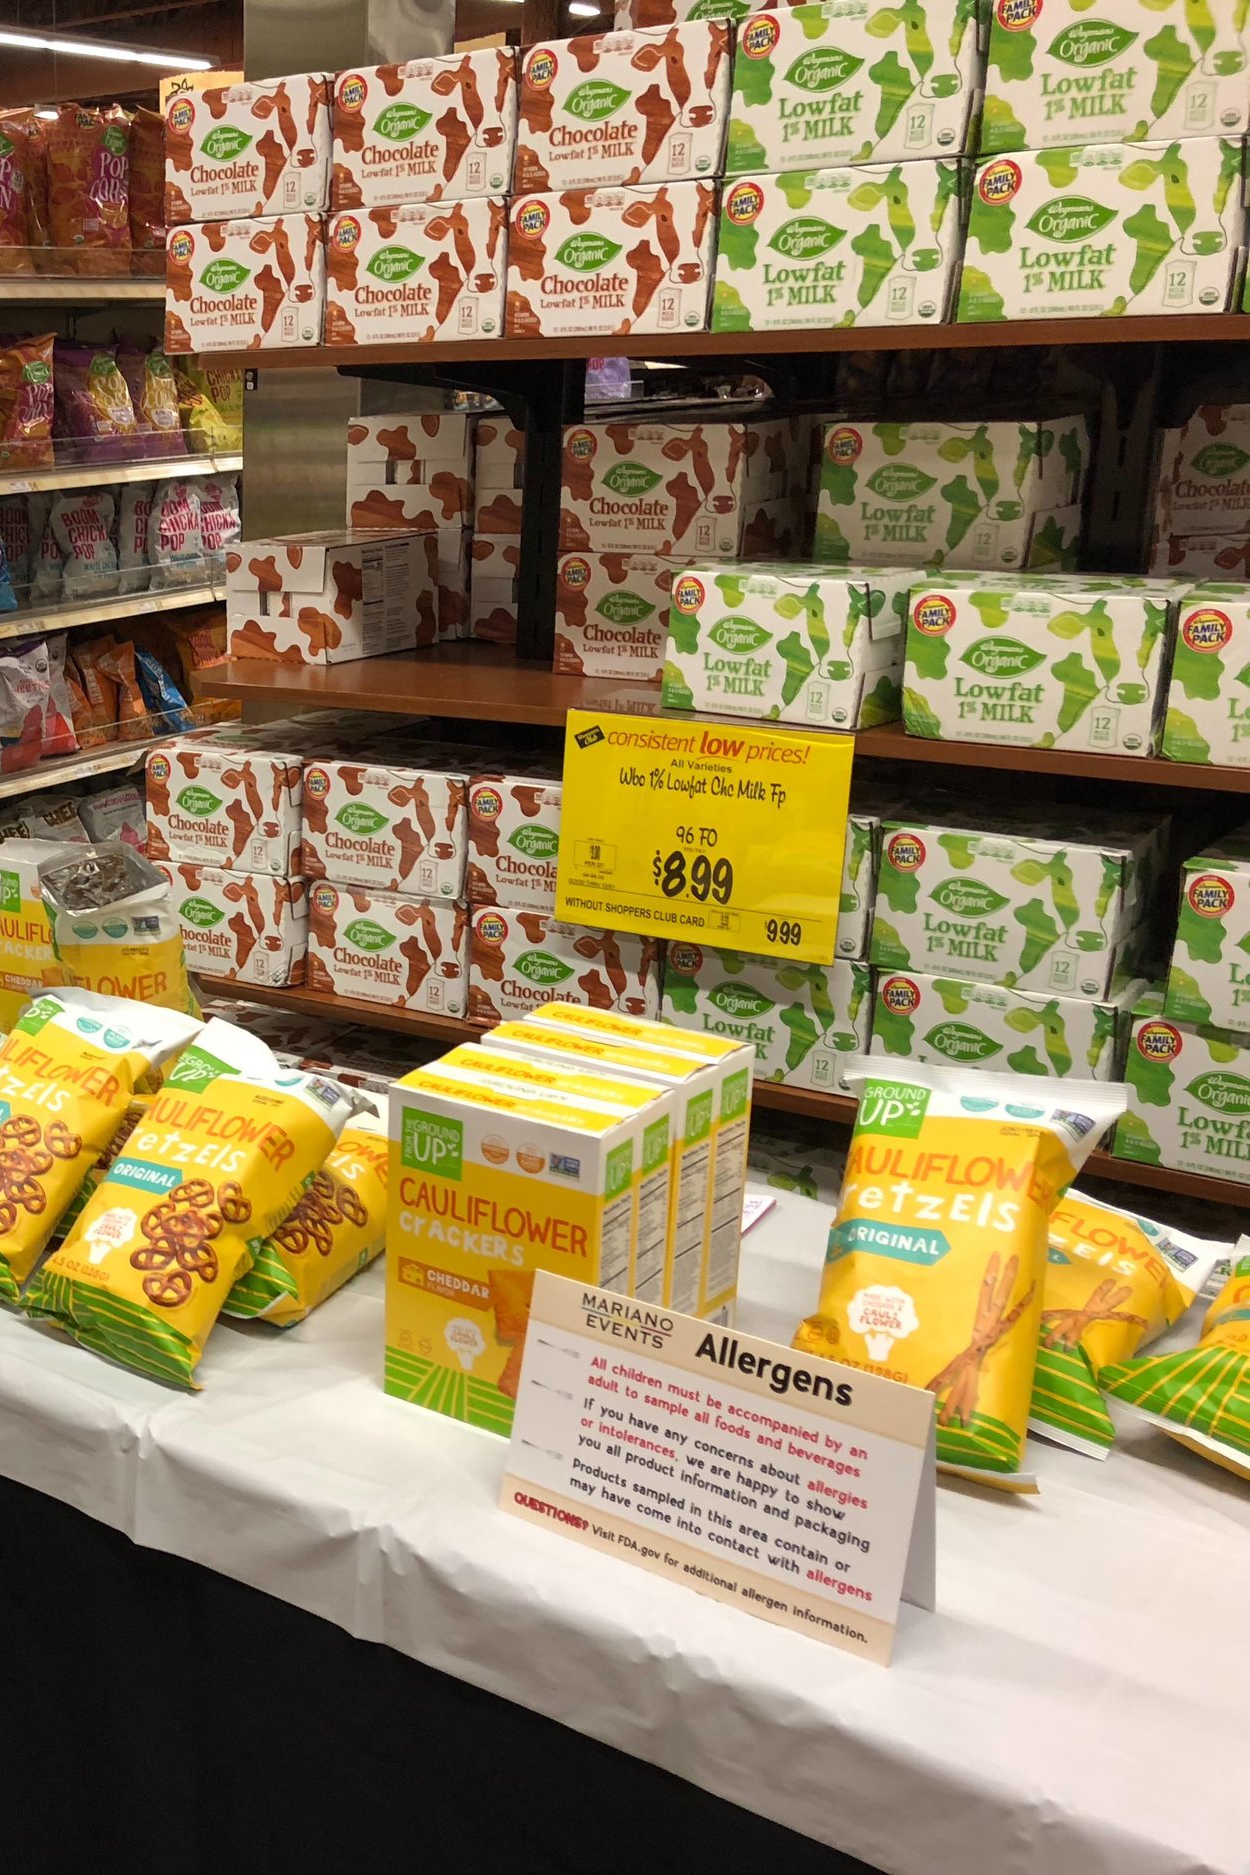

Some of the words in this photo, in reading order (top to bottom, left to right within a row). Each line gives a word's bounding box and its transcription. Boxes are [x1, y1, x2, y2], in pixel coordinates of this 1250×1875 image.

[1041, 67, 1137, 95] Lowfat
[1068, 94, 1127, 119] MILK
[983, 172, 1015, 188] FAMILY
[985, 182, 1015, 197] PACK
[1047, 203, 1093, 217] Wegmans
[1038, 212, 1099, 238] Organic
[564, 240, 609, 267] Organic
[1019, 244, 1116, 271] Lowfat
[540, 273, 629, 295] Chocolate
[1047, 271, 1105, 291] MILK
[1168, 272, 1186, 287] 12
[189, 295, 257, 314] Chocolate
[540, 297, 577, 309] Lowfat
[592, 294, 625, 308] MILK
[61, 511, 99, 526] BOOM
[73, 544, 95, 559] POP
[953, 681, 1044, 704] Lowfat
[974, 703, 1033, 724] MILK
[608, 730, 696, 753] consistent
[700, 731, 744, 758] low
[746, 746, 810, 764] prices!
[671, 759, 685, 768] All
[688, 761, 732, 773] Varieties
[620, 767, 646, 786] Wbo
[650, 768, 664, 789] 1%
[667, 776, 707, 798] Lowfat
[711, 776, 734, 798] Chc
[738, 782, 766, 800] Milk
[770, 784, 786, 808] Fp
[325, 832, 395, 856] Chocolate
[676, 826, 694, 843] 96
[700, 828, 718, 847] FO
[366, 852, 393, 870] MILK
[566, 897, 603, 912] WITHOUT
[606, 902, 651, 919] SHOPPERS
[654, 910, 678, 923] CLUB
[680, 914, 704, 927] CARD
[334, 947, 402, 972] Chocolate
[418, 1080, 516, 1108] CAULIFLOWER
[864, 1086, 926, 1102] GROUND
[860, 1101, 904, 1127] UP
[413, 1119, 460, 1141] GROUND
[414, 1132, 446, 1165] UP
[113, 1162, 175, 1188] ORIGINAL
[400, 1177, 588, 1257] CAULIFLOWER
[427, 1270, 490, 1299] CHEDDAR
[582, 1293, 673, 1332] MARIANO
[586, 1314, 663, 1349] EVENTS
[695, 1333, 853, 1406] Allergens
[591, 1357, 606, 1370] All
[612, 1364, 662, 1389] children
[668, 1383, 700, 1402] must
[707, 1394, 722, 1409] be
[728, 1405, 819, 1444] accompanied
[825, 1435, 842, 1452] by
[850, 1447, 867, 1460] an
[588, 1375, 618, 1393] adult
[626, 1386, 638, 1399] to
[645, 1395, 688, 1416] sample
[695, 1412, 709, 1424] all
[715, 1416, 750, 1439] foods
[757, 1434, 782, 1450] and
[788, 1442, 860, 1477] beverages
[584, 1398, 595, 1410] If
[600, 1405, 623, 1421] you
[629, 1413, 658, 1433] have
[665, 1428, 688, 1445] any
[695, 1440, 753, 1468] concerns
[760, 1463, 800, 1485] about
[807, 1480, 868, 1509] allergies
[581, 1416, 593, 1428] or
[686, 1455, 704, 1469] we
[710, 1464, 731, 1479] are
[737, 1471, 778, 1498] happy
[785, 1489, 799, 1505] to
[806, 1499, 845, 1520] show
[578, 1434, 600, 1450] you
[606, 1444, 620, 1458] all
[625, 1452, 674, 1477] product
[681, 1469, 757, 1509] information
[764, 1503, 789, 1521] and
[795, 1515, 870, 1553] packaging
[573, 1458, 626, 1488] Products
[633, 1482, 685, 1510] sampled
[690, 1502, 701, 1517] in
[708, 1509, 732, 1529] this
[739, 1524, 768, 1543] area
[775, 1537, 828, 1565] contain
[835, 1559, 850, 1573] or
[570, 1477, 595, 1496] may
[602, 1486, 631, 1507] have
[637, 1504, 671, 1523] come
[677, 1516, 701, 1535] into
[708, 1532, 759, 1559] contact
[768, 1553, 799, 1574] with
[807, 1569, 872, 1601] allergens
[513, 1491, 589, 1531] QUESTIONS?
[592, 1524, 614, 1543] Visit
[618, 1534, 660, 1558] FDA.gov
[664, 1552, 679, 1567] for
[684, 1562, 737, 1592] additional
[742, 1585, 787, 1612] allergen
[793, 1605, 868, 1644] information.
